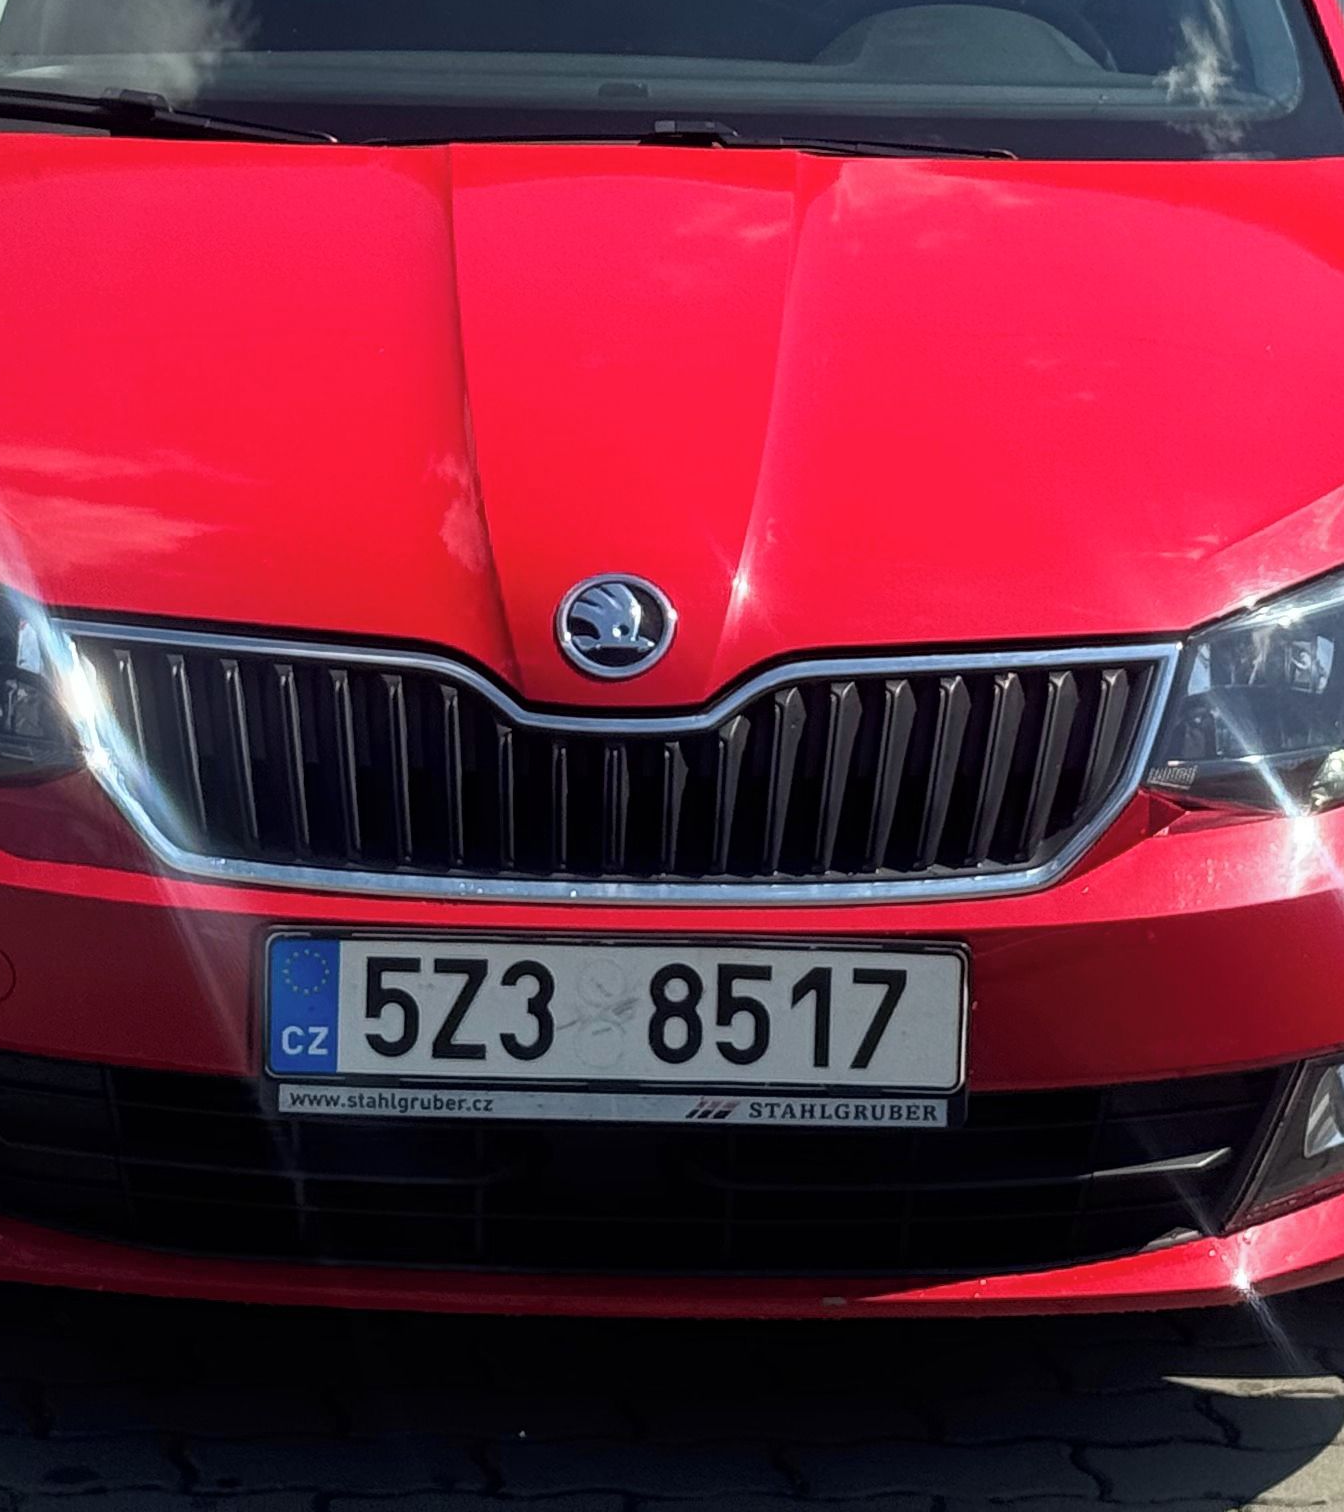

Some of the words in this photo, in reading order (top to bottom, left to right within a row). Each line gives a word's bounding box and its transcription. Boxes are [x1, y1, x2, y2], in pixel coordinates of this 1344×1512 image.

[364, 955, 557, 1062] 5Z3
[647, 961, 908, 1071] 8517
[281, 1025, 329, 1056] CZ
[289, 1092, 495, 1114] www.stahlgruber.cz
[748, 1101, 939, 1122] STAHLGRUBER
